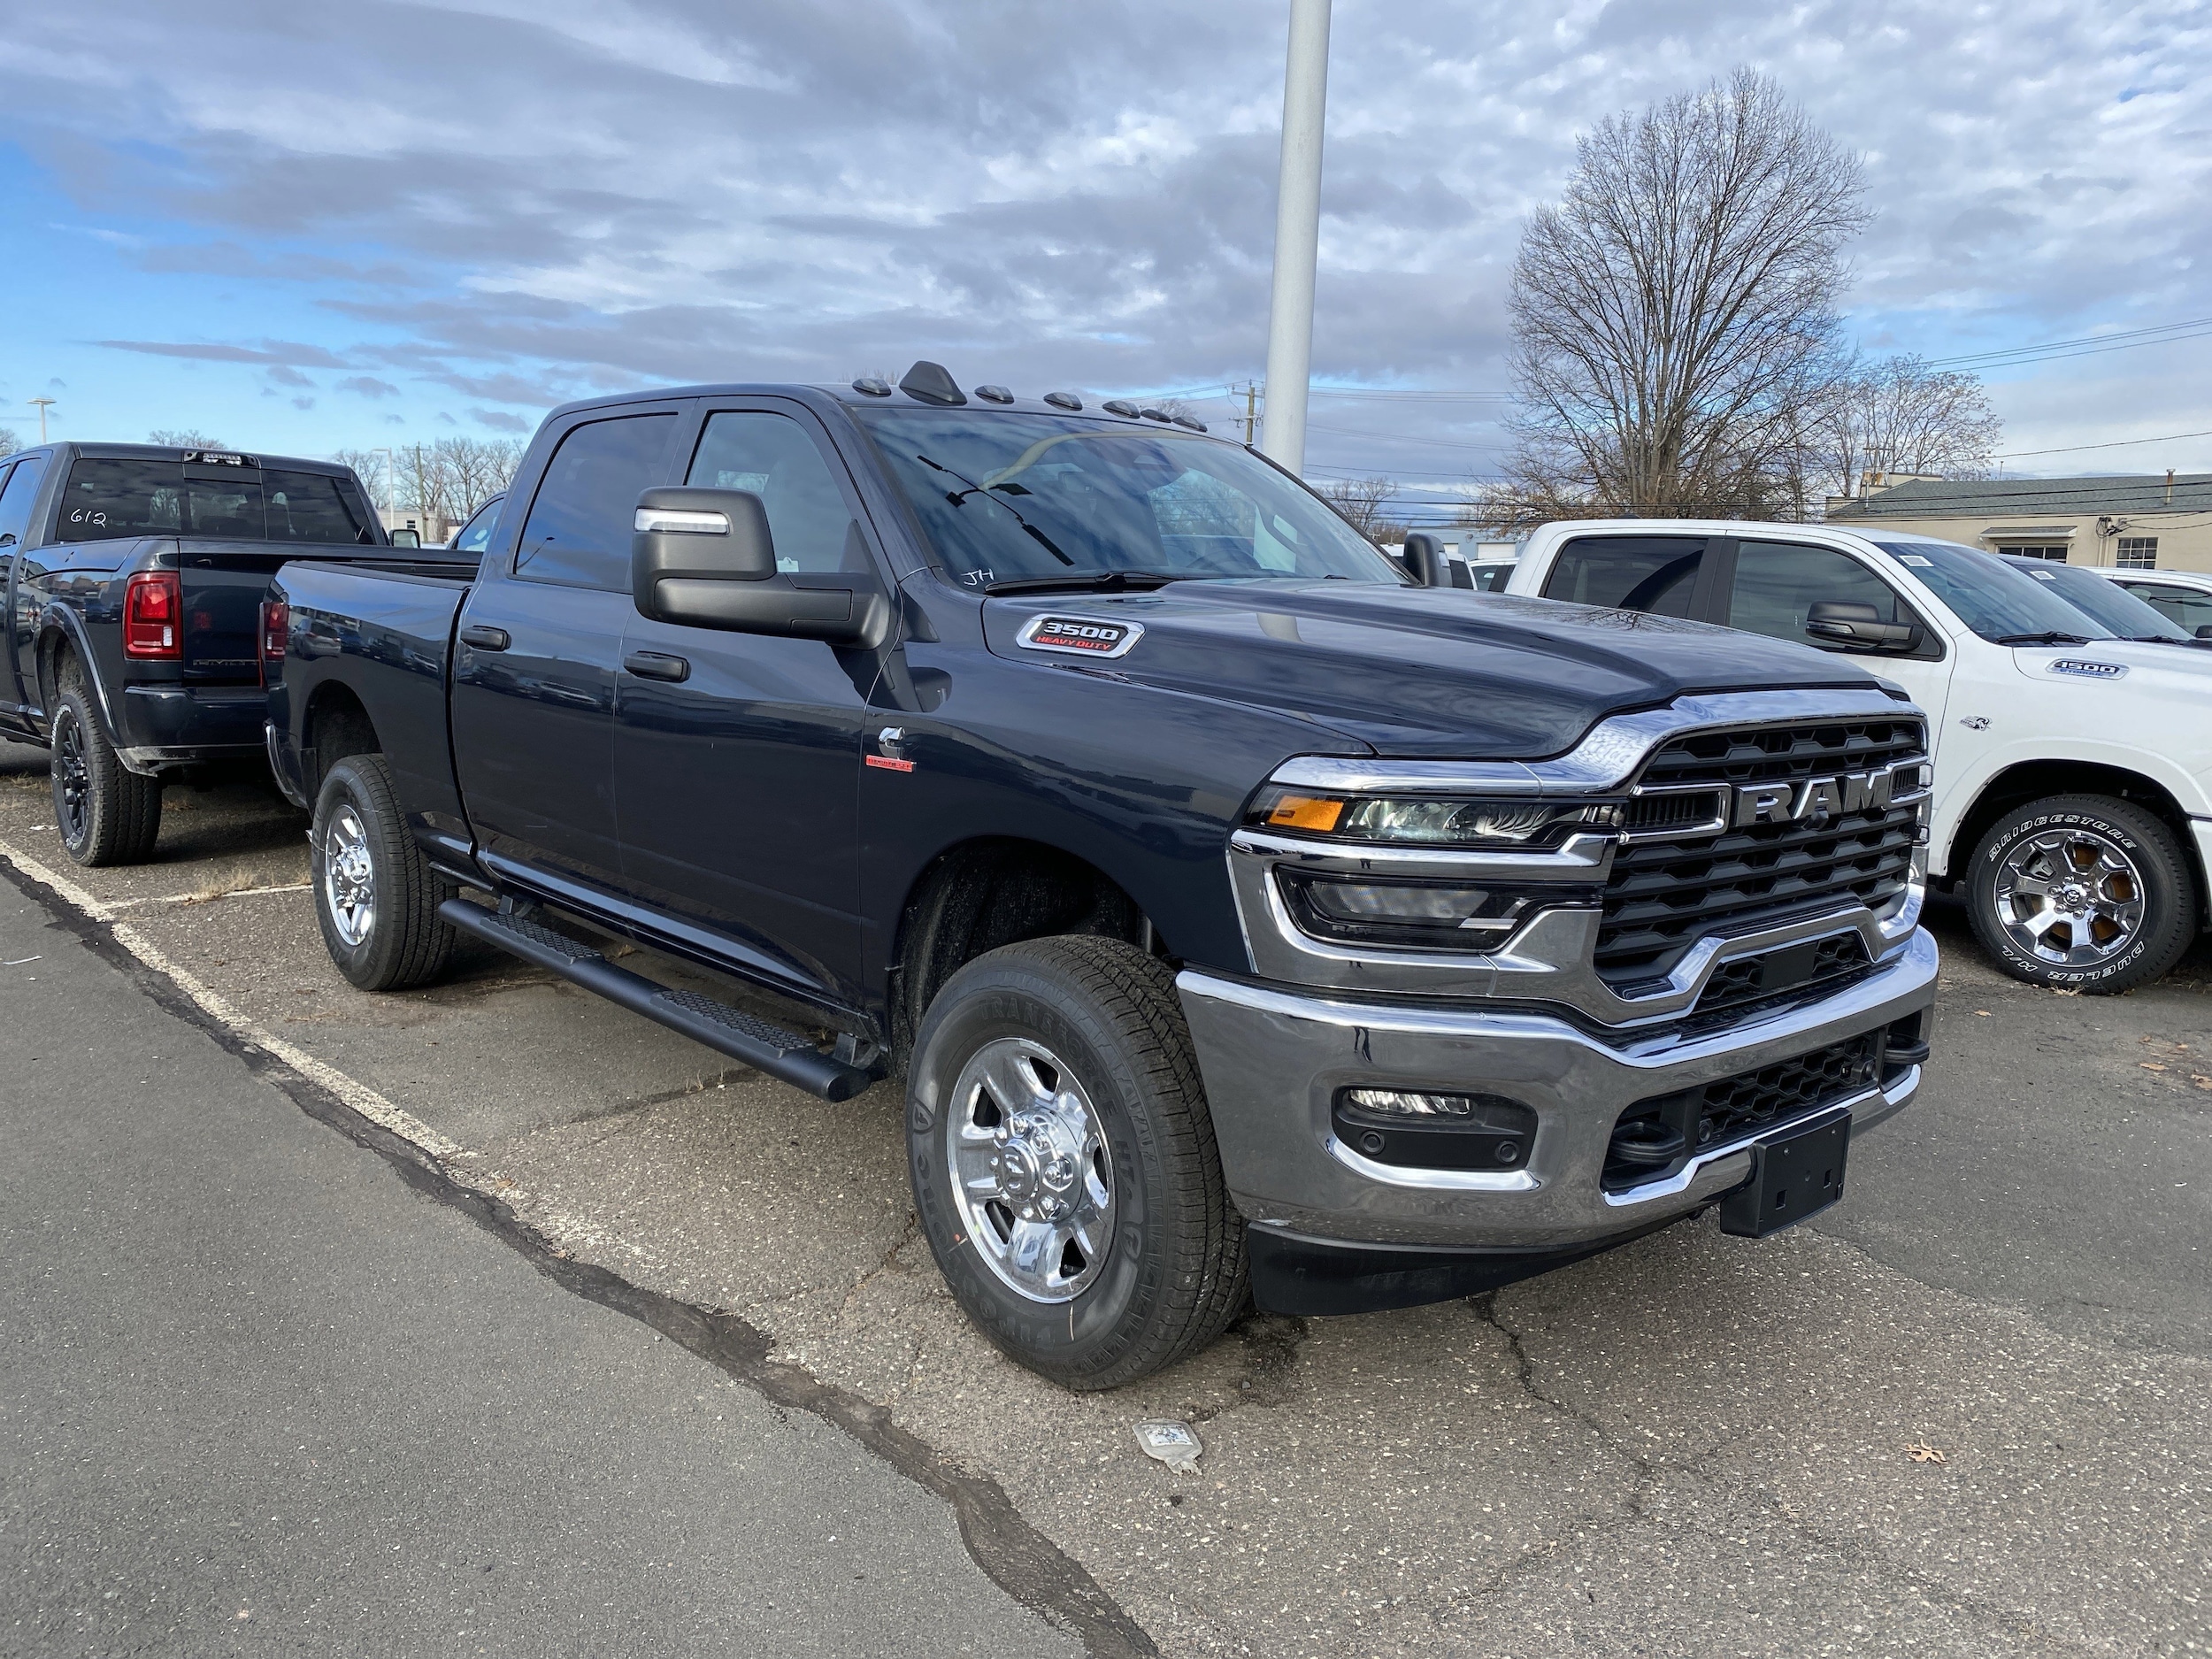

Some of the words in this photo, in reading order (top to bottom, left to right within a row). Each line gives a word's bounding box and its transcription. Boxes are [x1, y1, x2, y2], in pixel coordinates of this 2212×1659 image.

[70, 508, 107, 529] 612
[960, 567, 995, 586] JH
[1043, 622, 1119, 641] 3500
[1035, 635, 1076, 647] HEAVY
[1075, 640, 1112, 651] DUTY
[2061, 661, 2117, 673] 1500
[1735, 769, 1892, 828] RAM
[1988, 813, 2138, 862] BRIDGESTONE
[2001, 944, 2039, 972] H/L
[2047, 940, 2147, 982] DUELER
